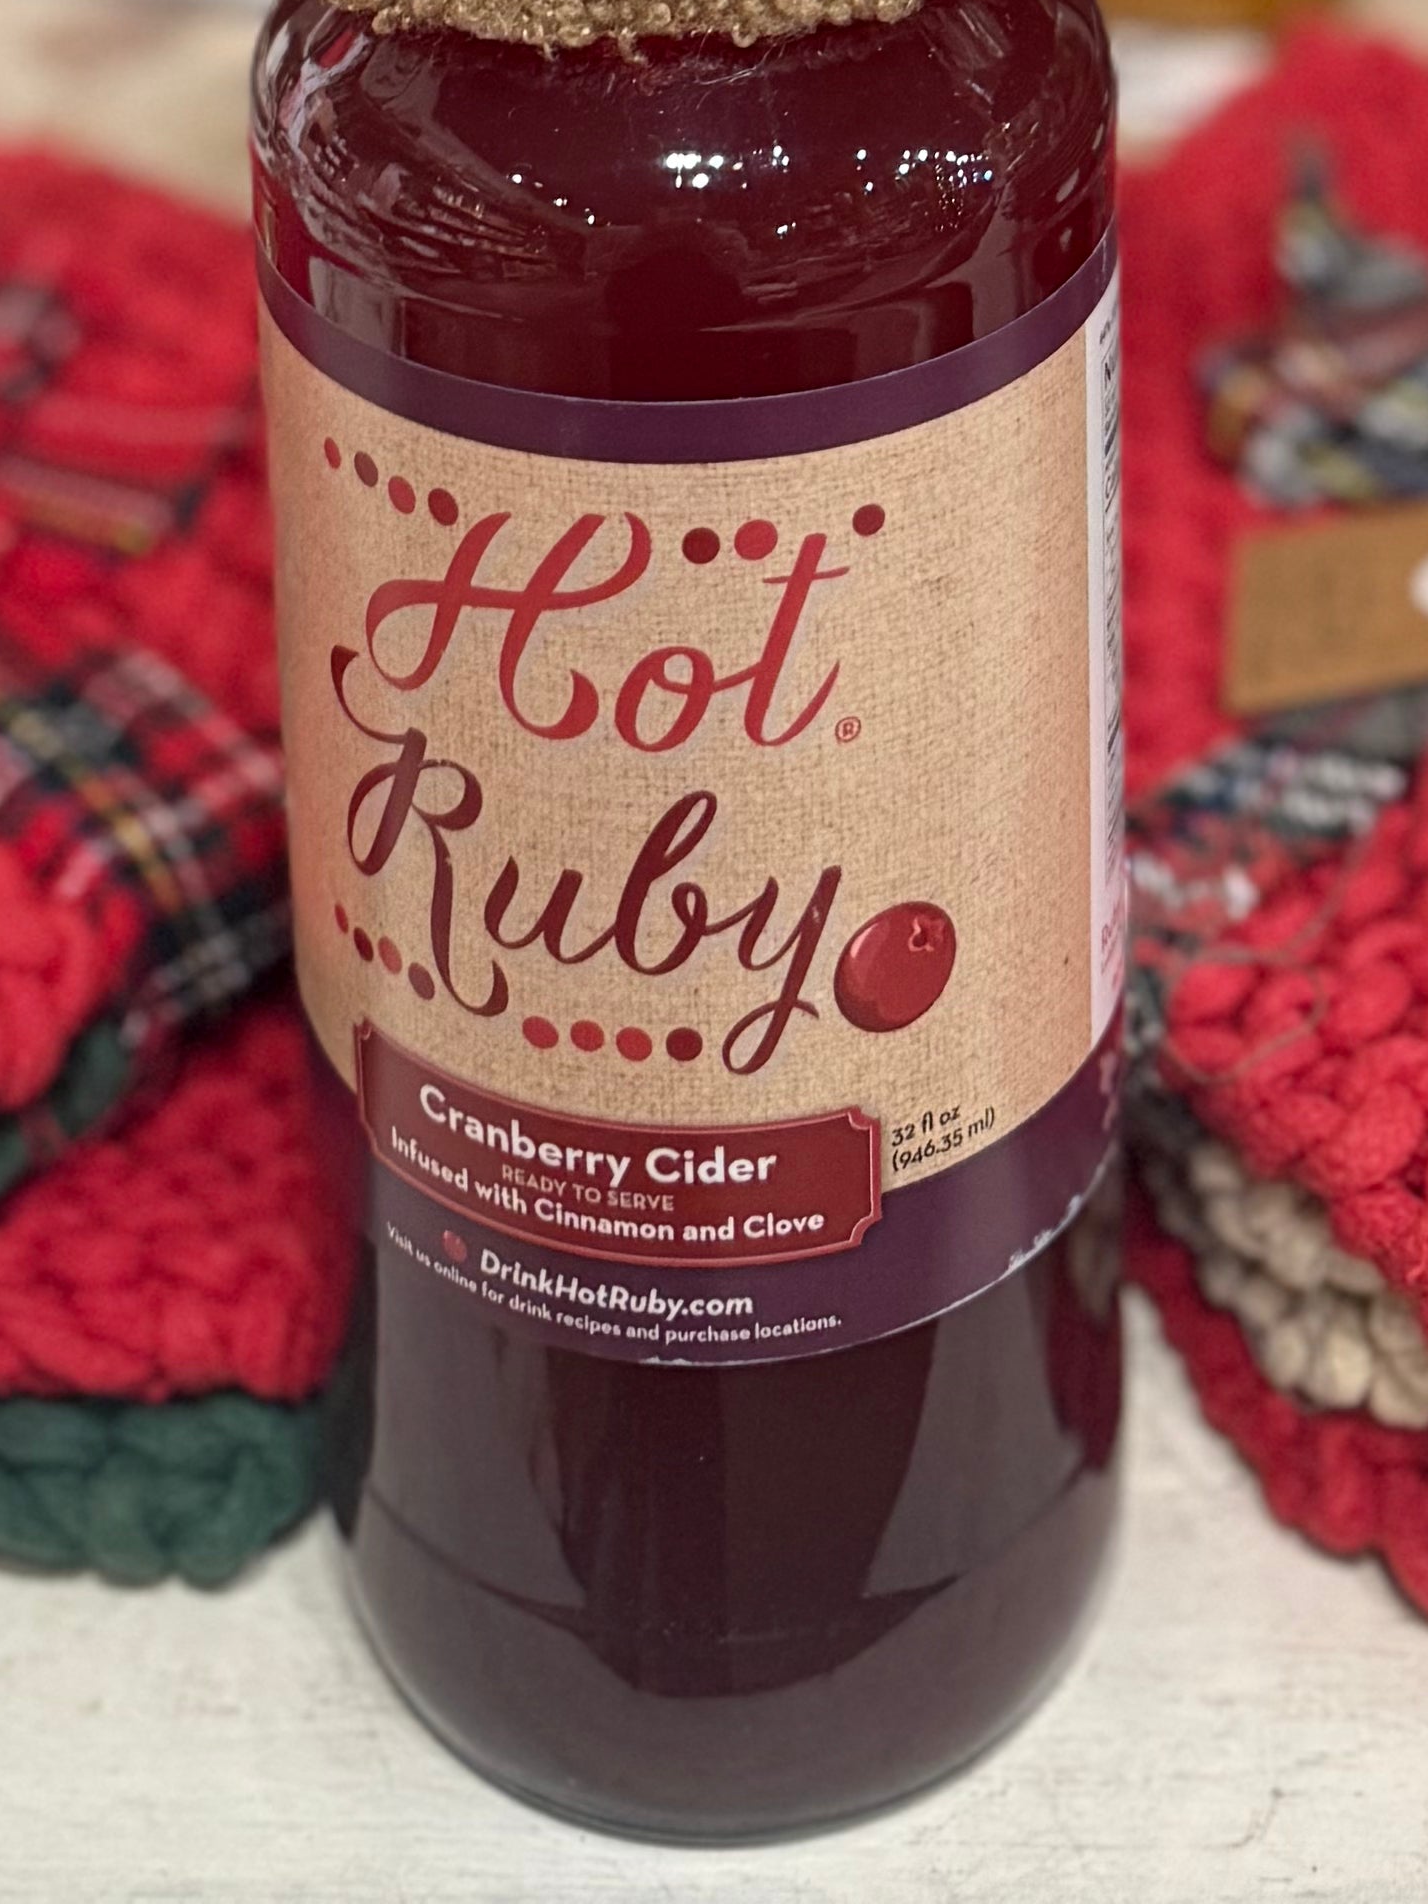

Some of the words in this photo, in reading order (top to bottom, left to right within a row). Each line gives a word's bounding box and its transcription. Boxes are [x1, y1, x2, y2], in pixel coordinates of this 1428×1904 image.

[330, 645, 842, 1075] Ruby
[419, 1083, 631, 1188] Cranberry
[645, 1145, 778, 1185] Cider
[891, 1123, 915, 1147] 32
[922, 1110, 934, 1134] fl
[939, 1104, 961, 1126] oz
[892, 1127, 963, 1172] (946.35
[968, 1105, 995, 1138] ml)
[391, 1125, 469, 1192] Infused
[474, 1180, 527, 1215] with
[533, 1197, 674, 1241] Cinnamon
[682, 1216, 735, 1242] and
[743, 1212, 825, 1238] Clove
[502, 1163, 568, 1196] READY
[572, 1182, 602, 1204] TO
[607, 1191, 675, 1212] SERVE
[387, 1221, 414, 1256] Visit
[416, 1248, 432, 1268] us
[433, 1261, 477, 1292] online
[481, 1280, 504, 1304] for
[509, 1293, 552, 1322] drink
[556, 1311, 622, 1336] recipes
[625, 1323, 660, 1341] and
[665, 1325, 751, 1346] purchase
[754, 1314, 843, 1340] locations.
[479, 1248, 754, 1322] DrinkHotRuby.com
